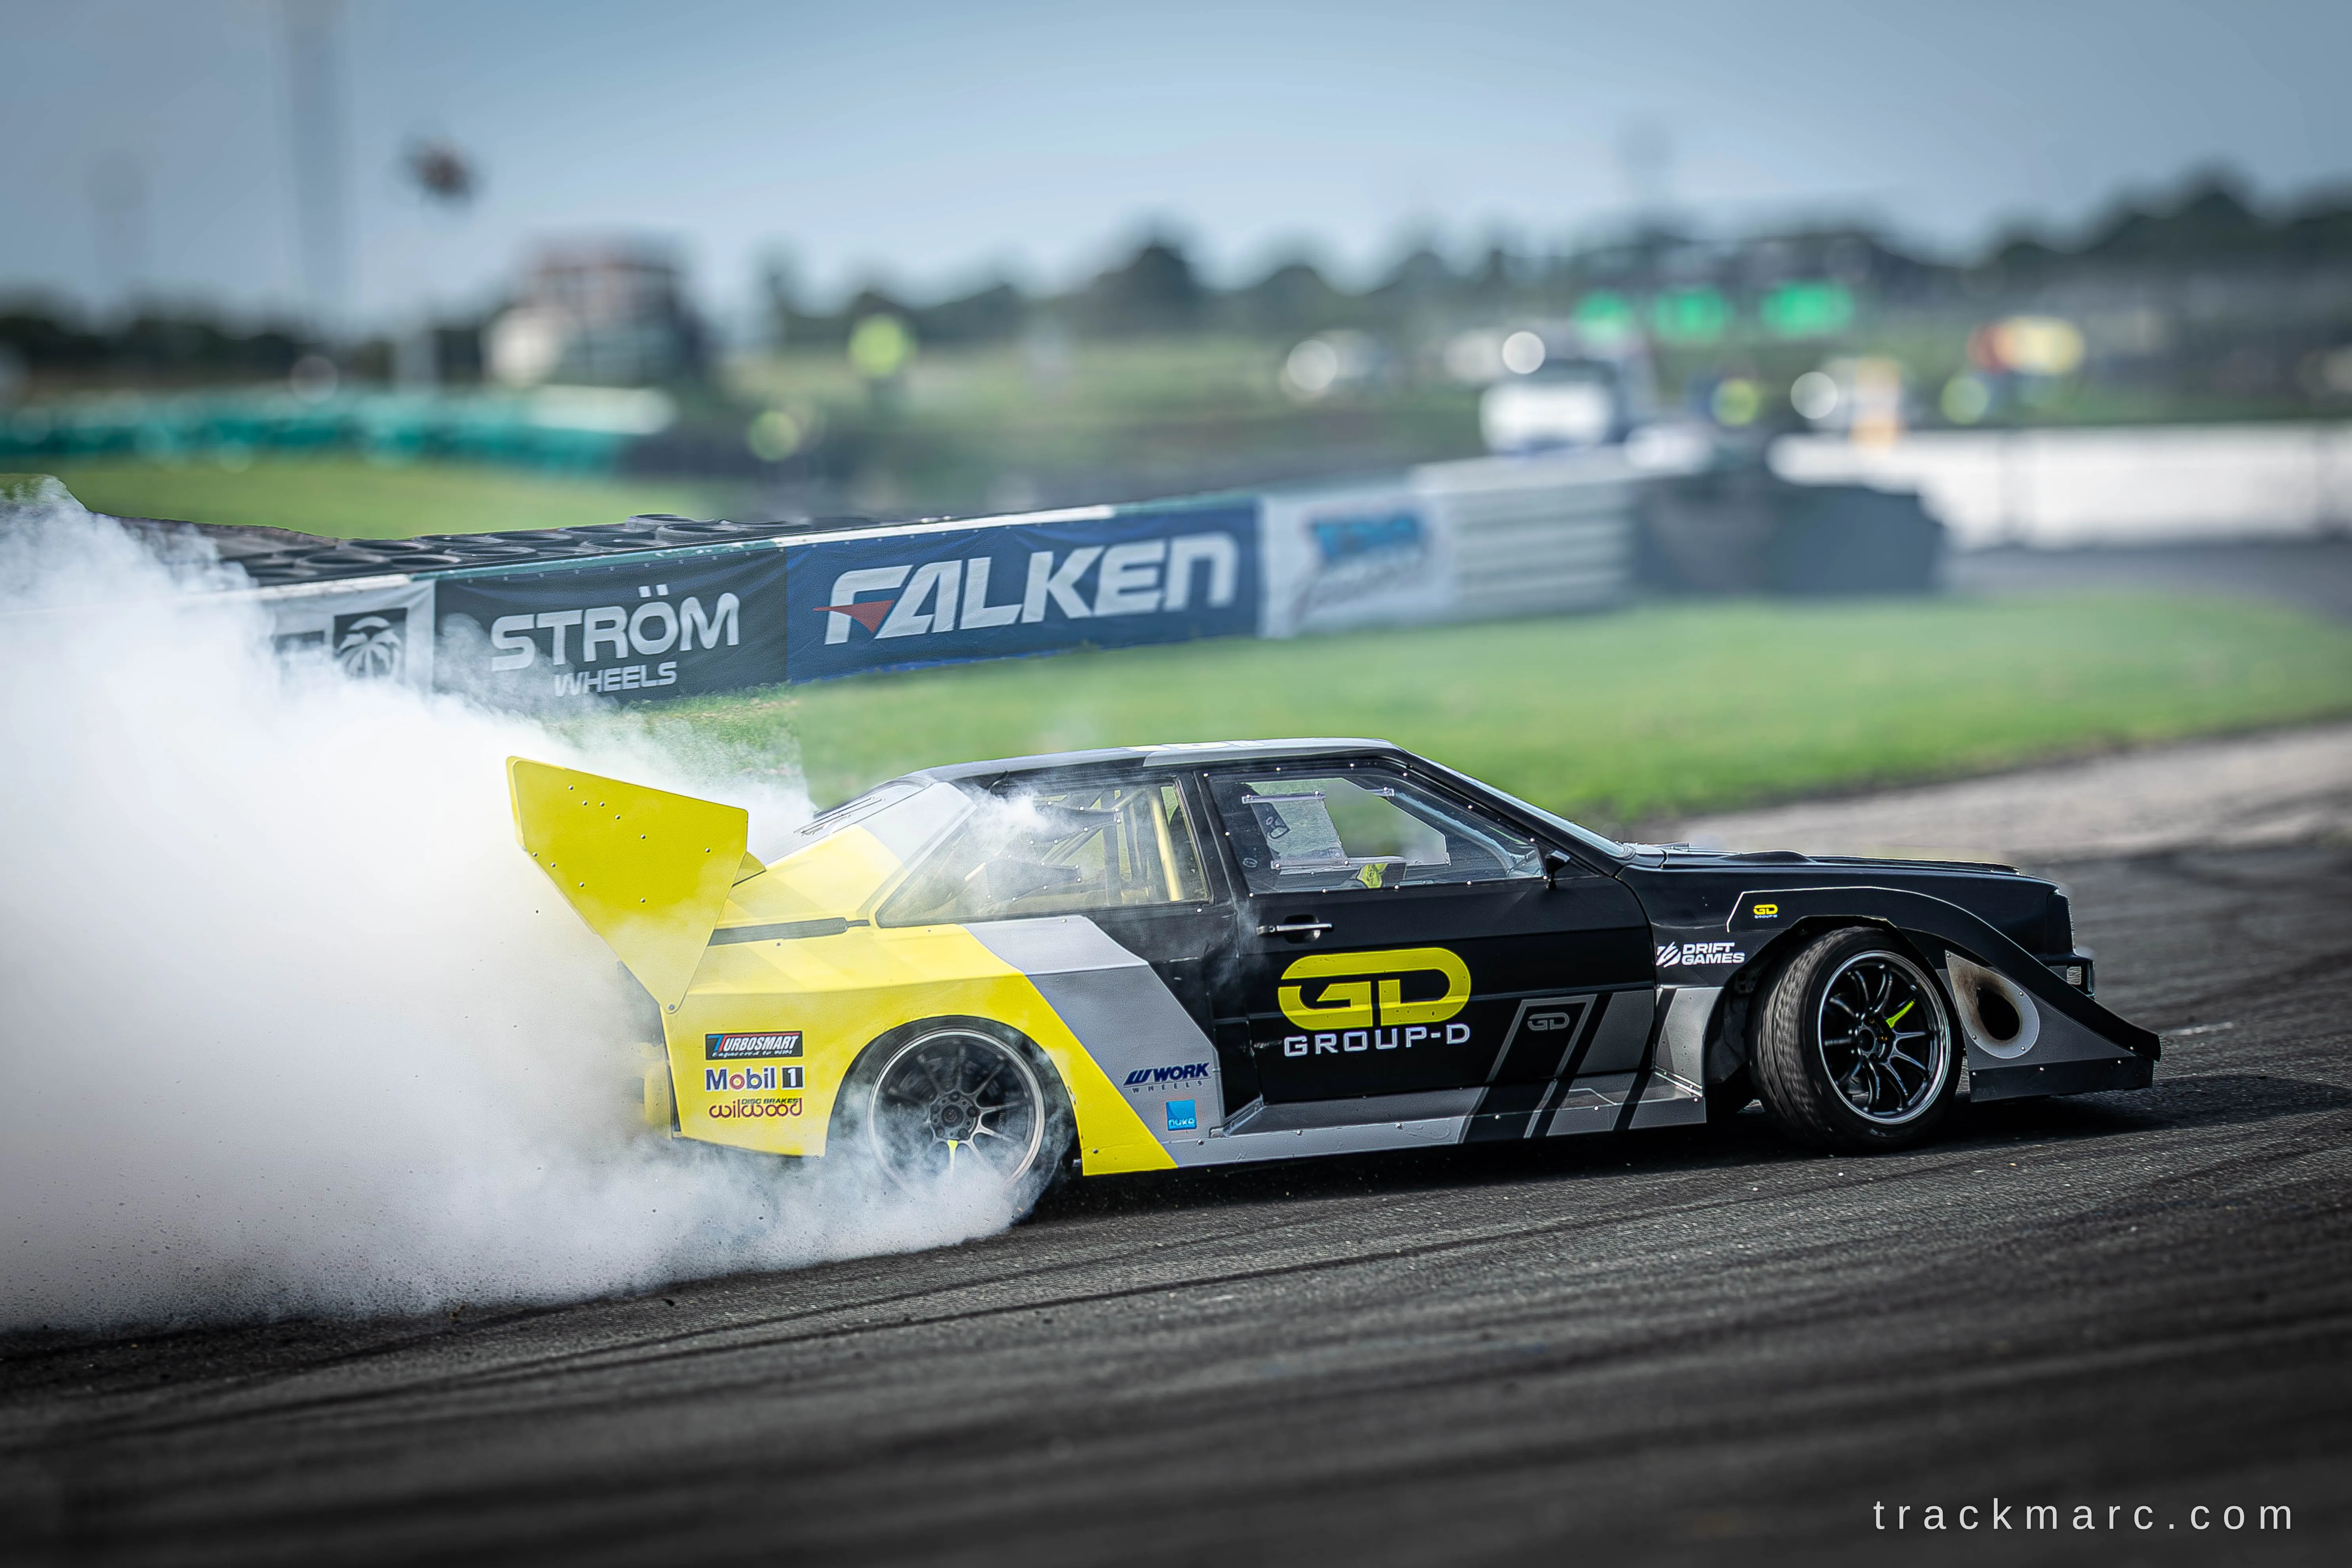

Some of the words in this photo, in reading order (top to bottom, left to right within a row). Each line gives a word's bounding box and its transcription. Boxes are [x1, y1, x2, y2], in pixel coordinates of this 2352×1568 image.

[824, 532, 1238, 646] FALKEN
[491, 584, 740, 672] STRÖM
[554, 662, 677, 697] WHEELS
[1681, 952, 1745, 966] GAMES
[1682, 942, 1735, 955] DRIFT
[1278, 947, 1471, 1030] GD
[1527, 1012, 1570, 1031] GD
[707, 1032, 800, 1052] TURBOSMART
[1283, 1023, 1471, 1057] GROUP-D
[706, 1067, 776, 1091] Mobil
[788, 1069, 797, 1087] 1
[1154, 1062, 1209, 1083] WORK
[1132, 1080, 1203, 1093] WHEELS
[709, 1097, 803, 1118] wilwood
[1168, 1117, 1195, 1126] nuke
